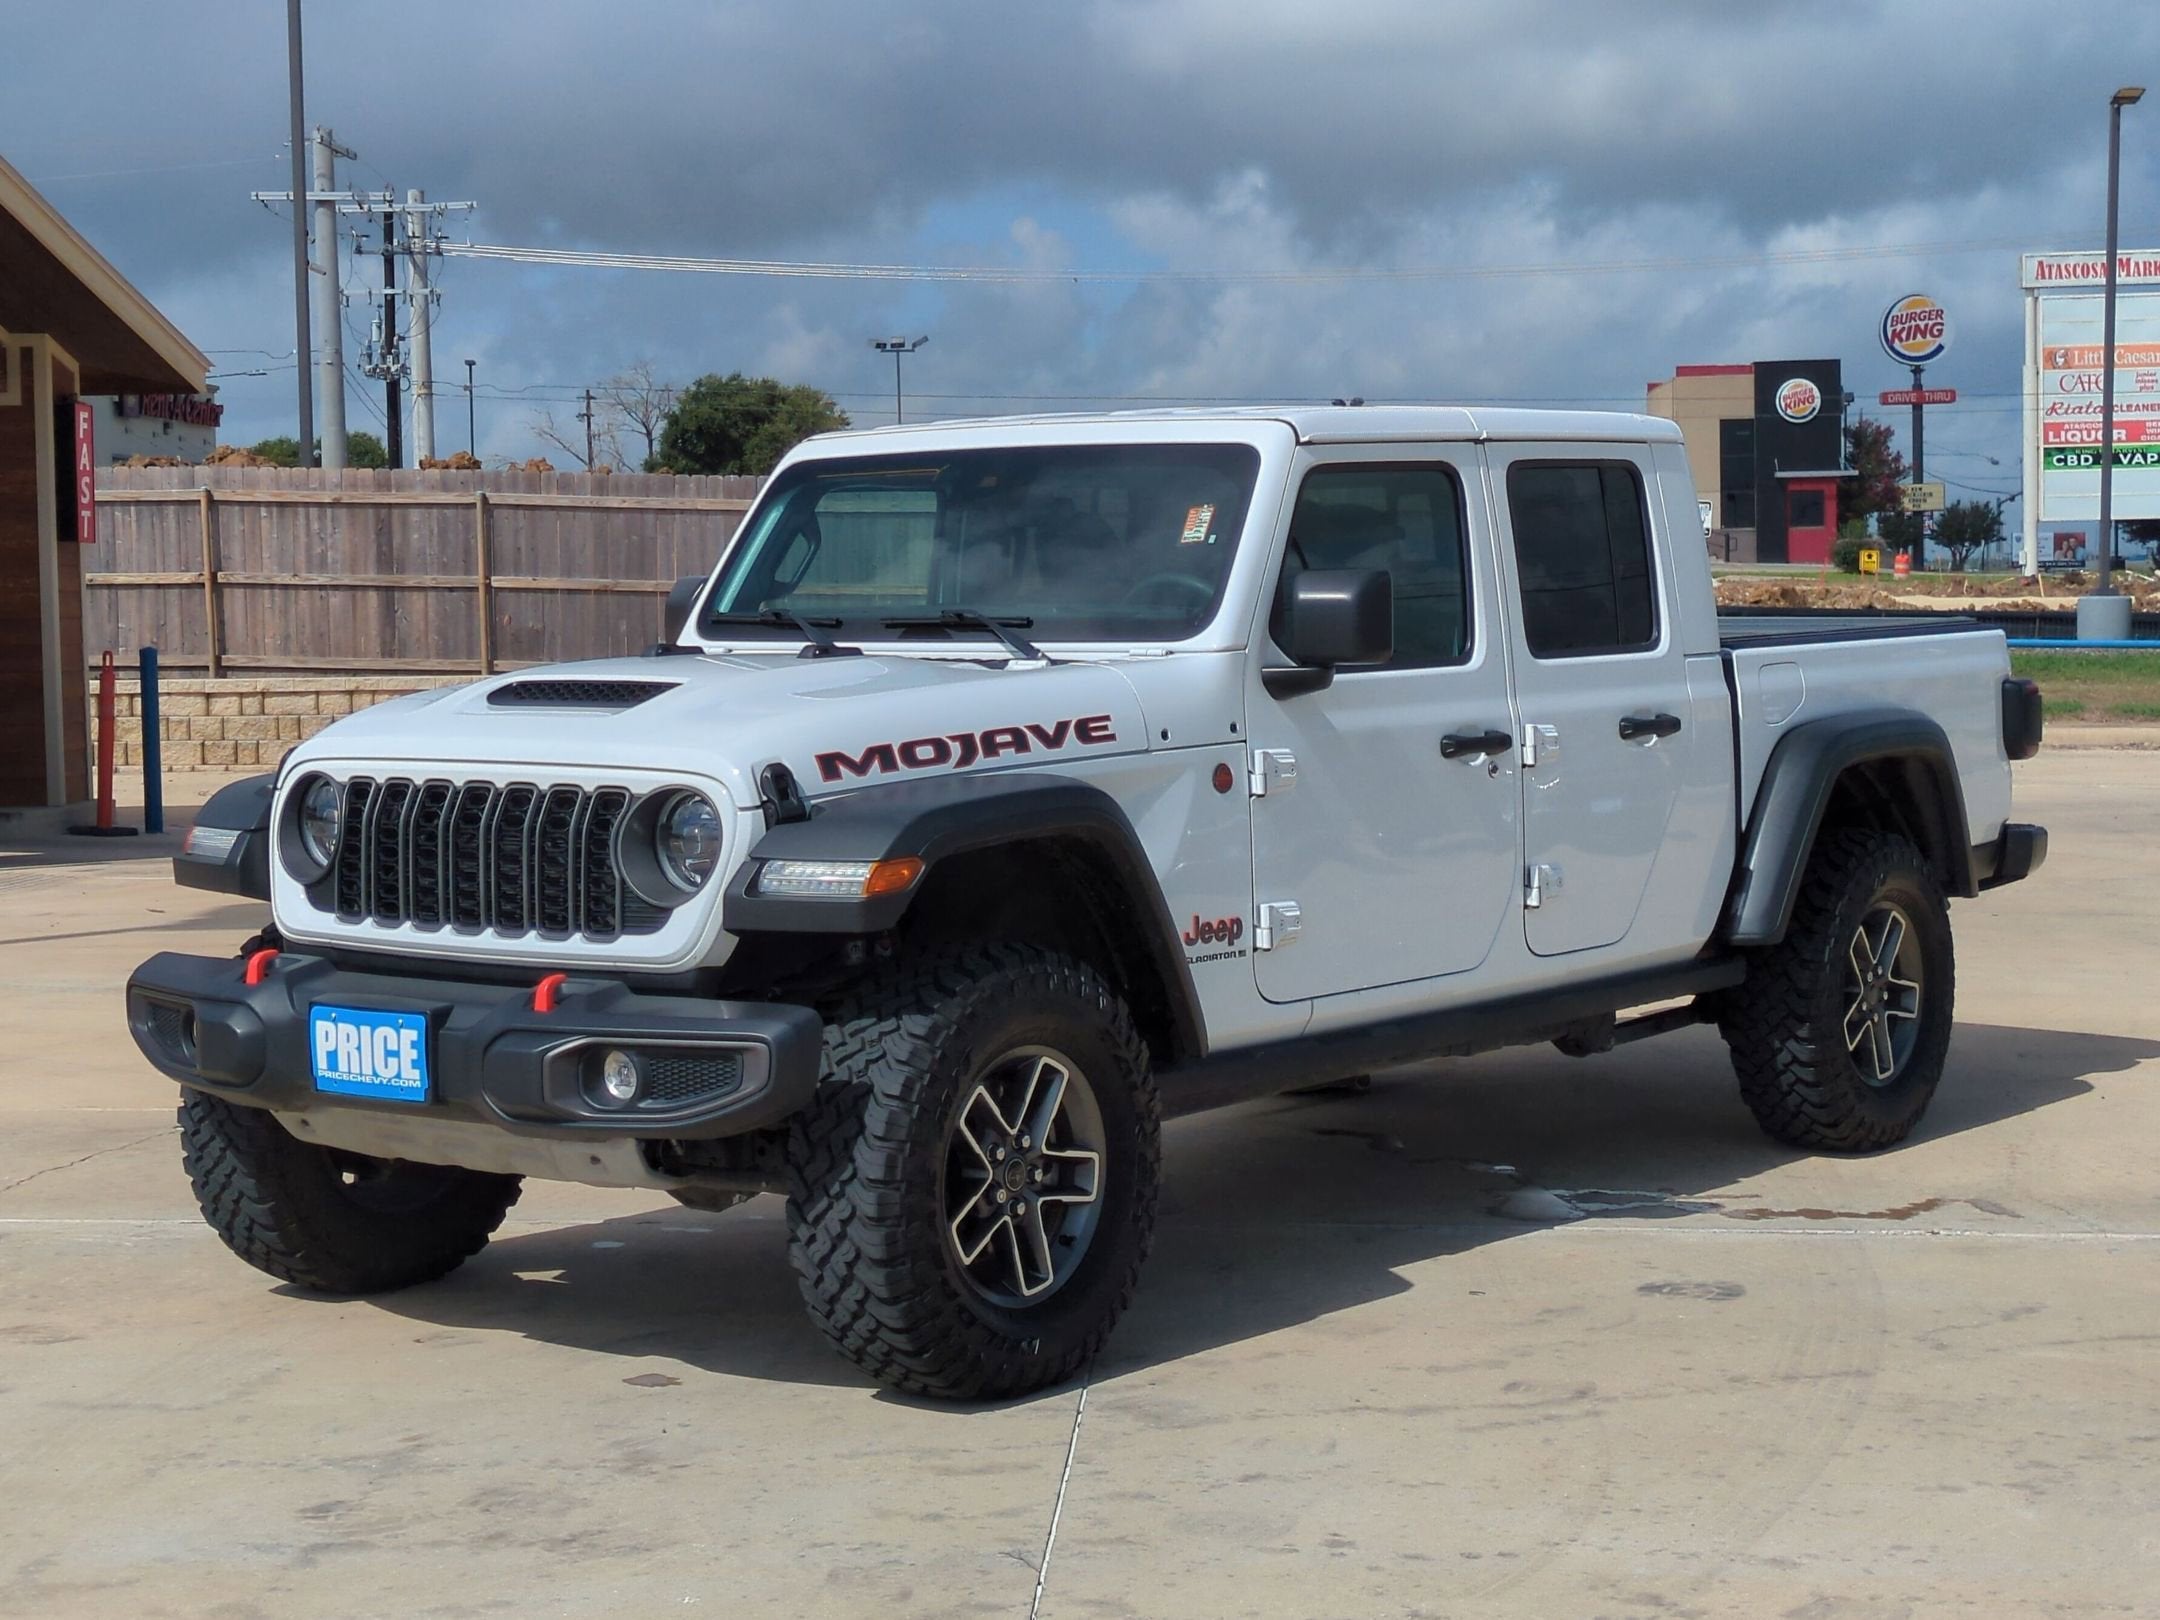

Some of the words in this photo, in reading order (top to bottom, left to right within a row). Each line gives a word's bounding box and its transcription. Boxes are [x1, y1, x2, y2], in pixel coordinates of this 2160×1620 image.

[2035, 260, 2107, 280] ATASCOSA
[1890, 308, 1944, 327] BURGER
[1889, 321, 1944, 346] KING
[2074, 350, 2105, 366] Littl
[1783, 387, 1814, 403] BURGER
[1784, 394, 1815, 412] KING
[1888, 393, 1917, 403] DRIVE
[1924, 391, 1951, 402] THRU
[2064, 422, 2103, 430] ATASCO
[2052, 455, 2093, 467] CBD
[79, 411, 91, 538] FAST
[814, 714, 1117, 783] MOJAVE
[1183, 914, 1243, 946] Jeep
[315, 1019, 420, 1080] PRICE
[318, 1070, 421, 1088] PRICECHEVY.COM
